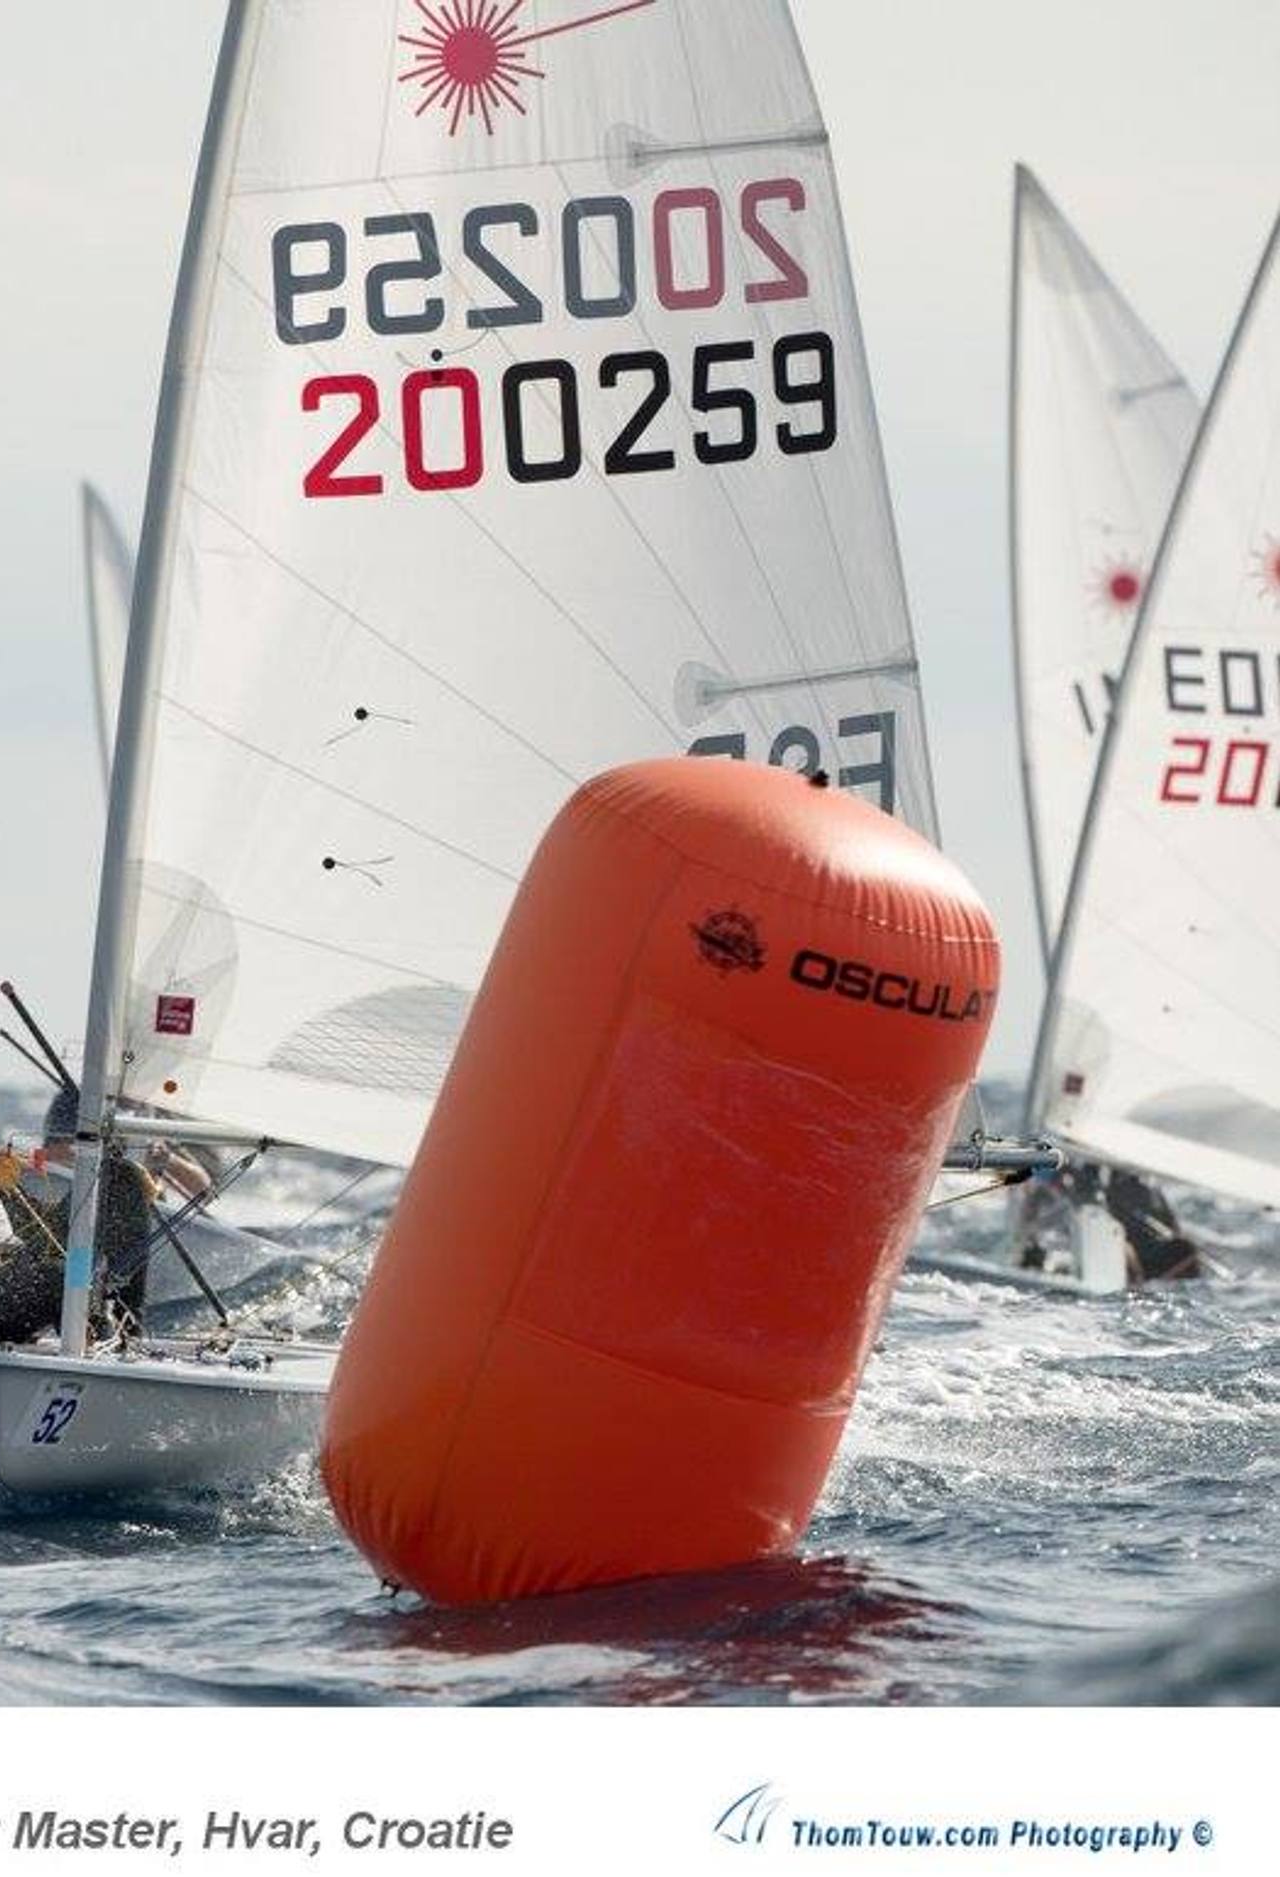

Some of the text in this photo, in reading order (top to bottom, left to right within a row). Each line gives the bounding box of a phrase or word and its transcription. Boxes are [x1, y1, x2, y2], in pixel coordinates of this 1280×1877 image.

[301, 330, 838, 499] 200259
[1160, 737, 1280, 809] 20
[32, 1399, 78, 1444] 52
